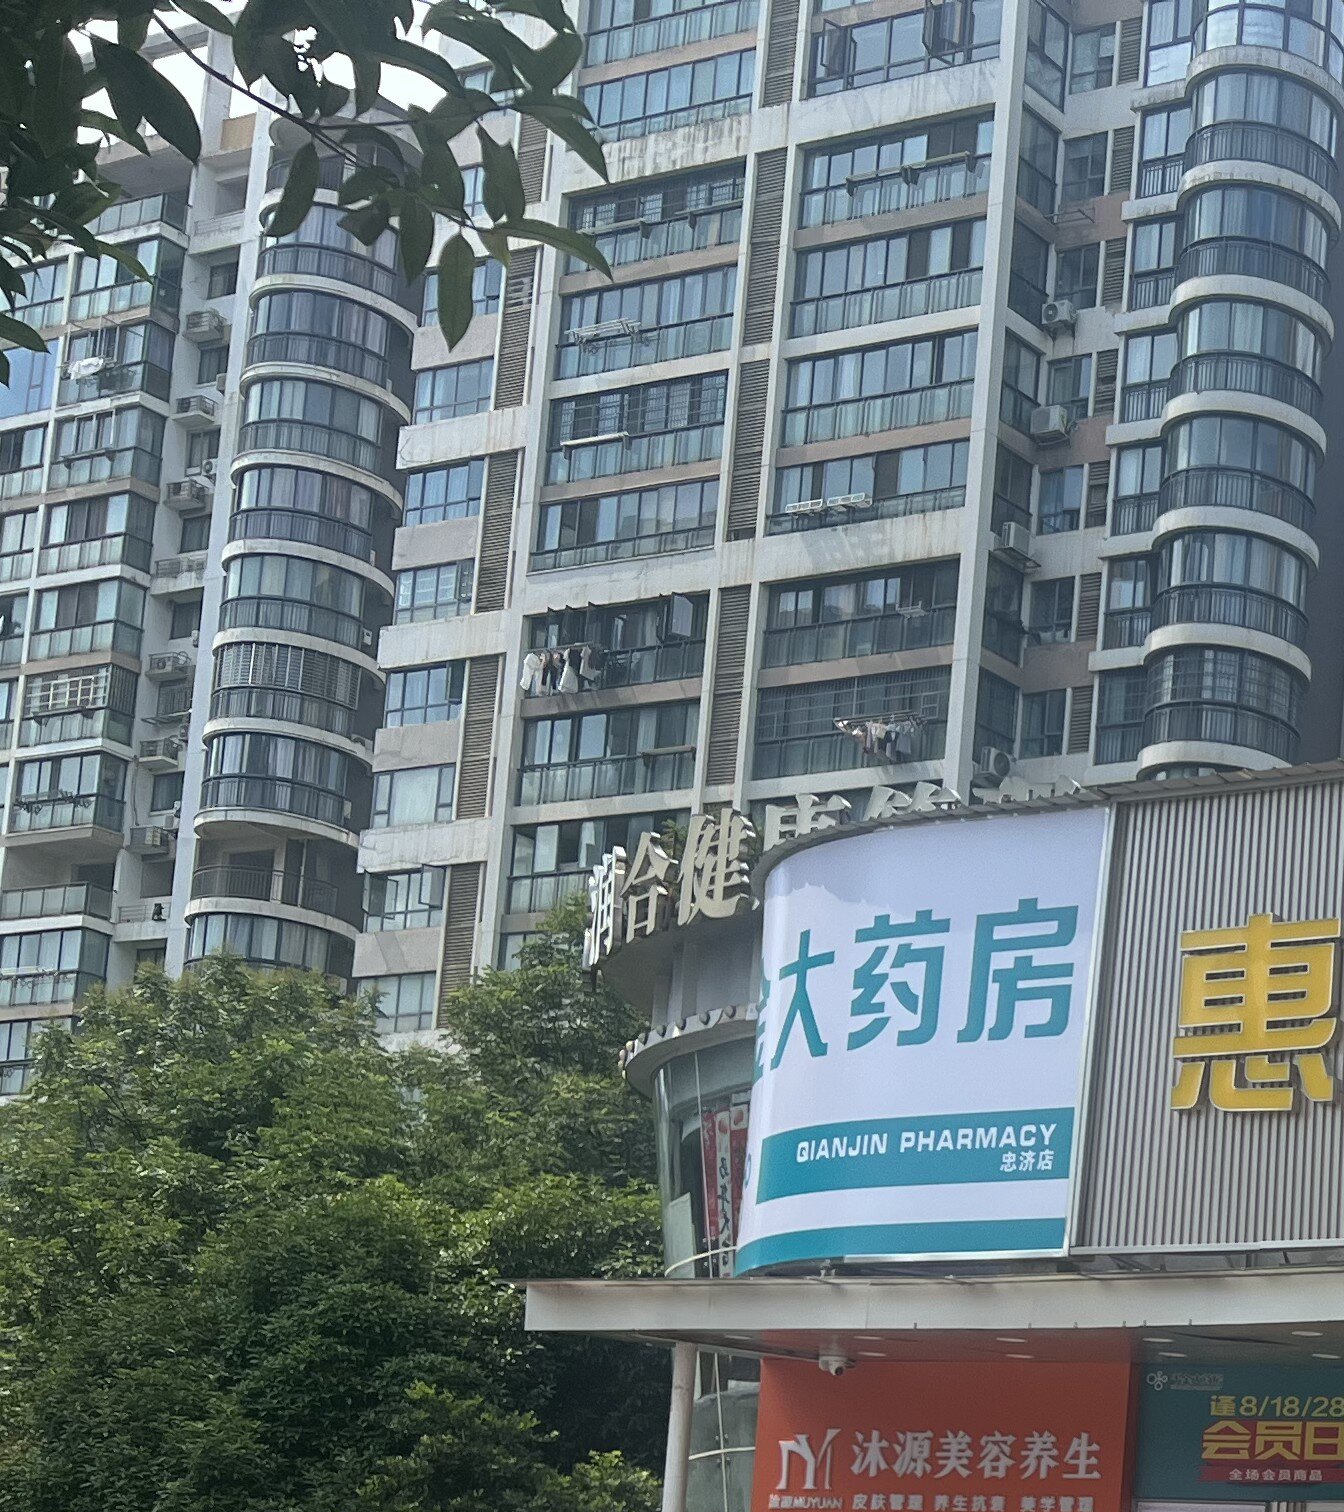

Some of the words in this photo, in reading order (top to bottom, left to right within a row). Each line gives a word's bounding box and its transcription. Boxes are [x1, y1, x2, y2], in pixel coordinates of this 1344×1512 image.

[756, 898, 1079, 1080] 大药房
[796, 1133, 888, 1163] QIANJIN
[899, 1123, 1057, 1153] PHARMACY
[999, 1150, 1055, 1172] 忠济店
[850, 1429, 1102, 1480] 沐源美容养生
[1228, 1468, 1323, 1481] 全场会员商品
[852, 1494, 923, 1511] 皮肤管理
[934, 1494, 1006, 1512] 养生抗衰
[1020, 1496, 1093, 1512] 美学管理
